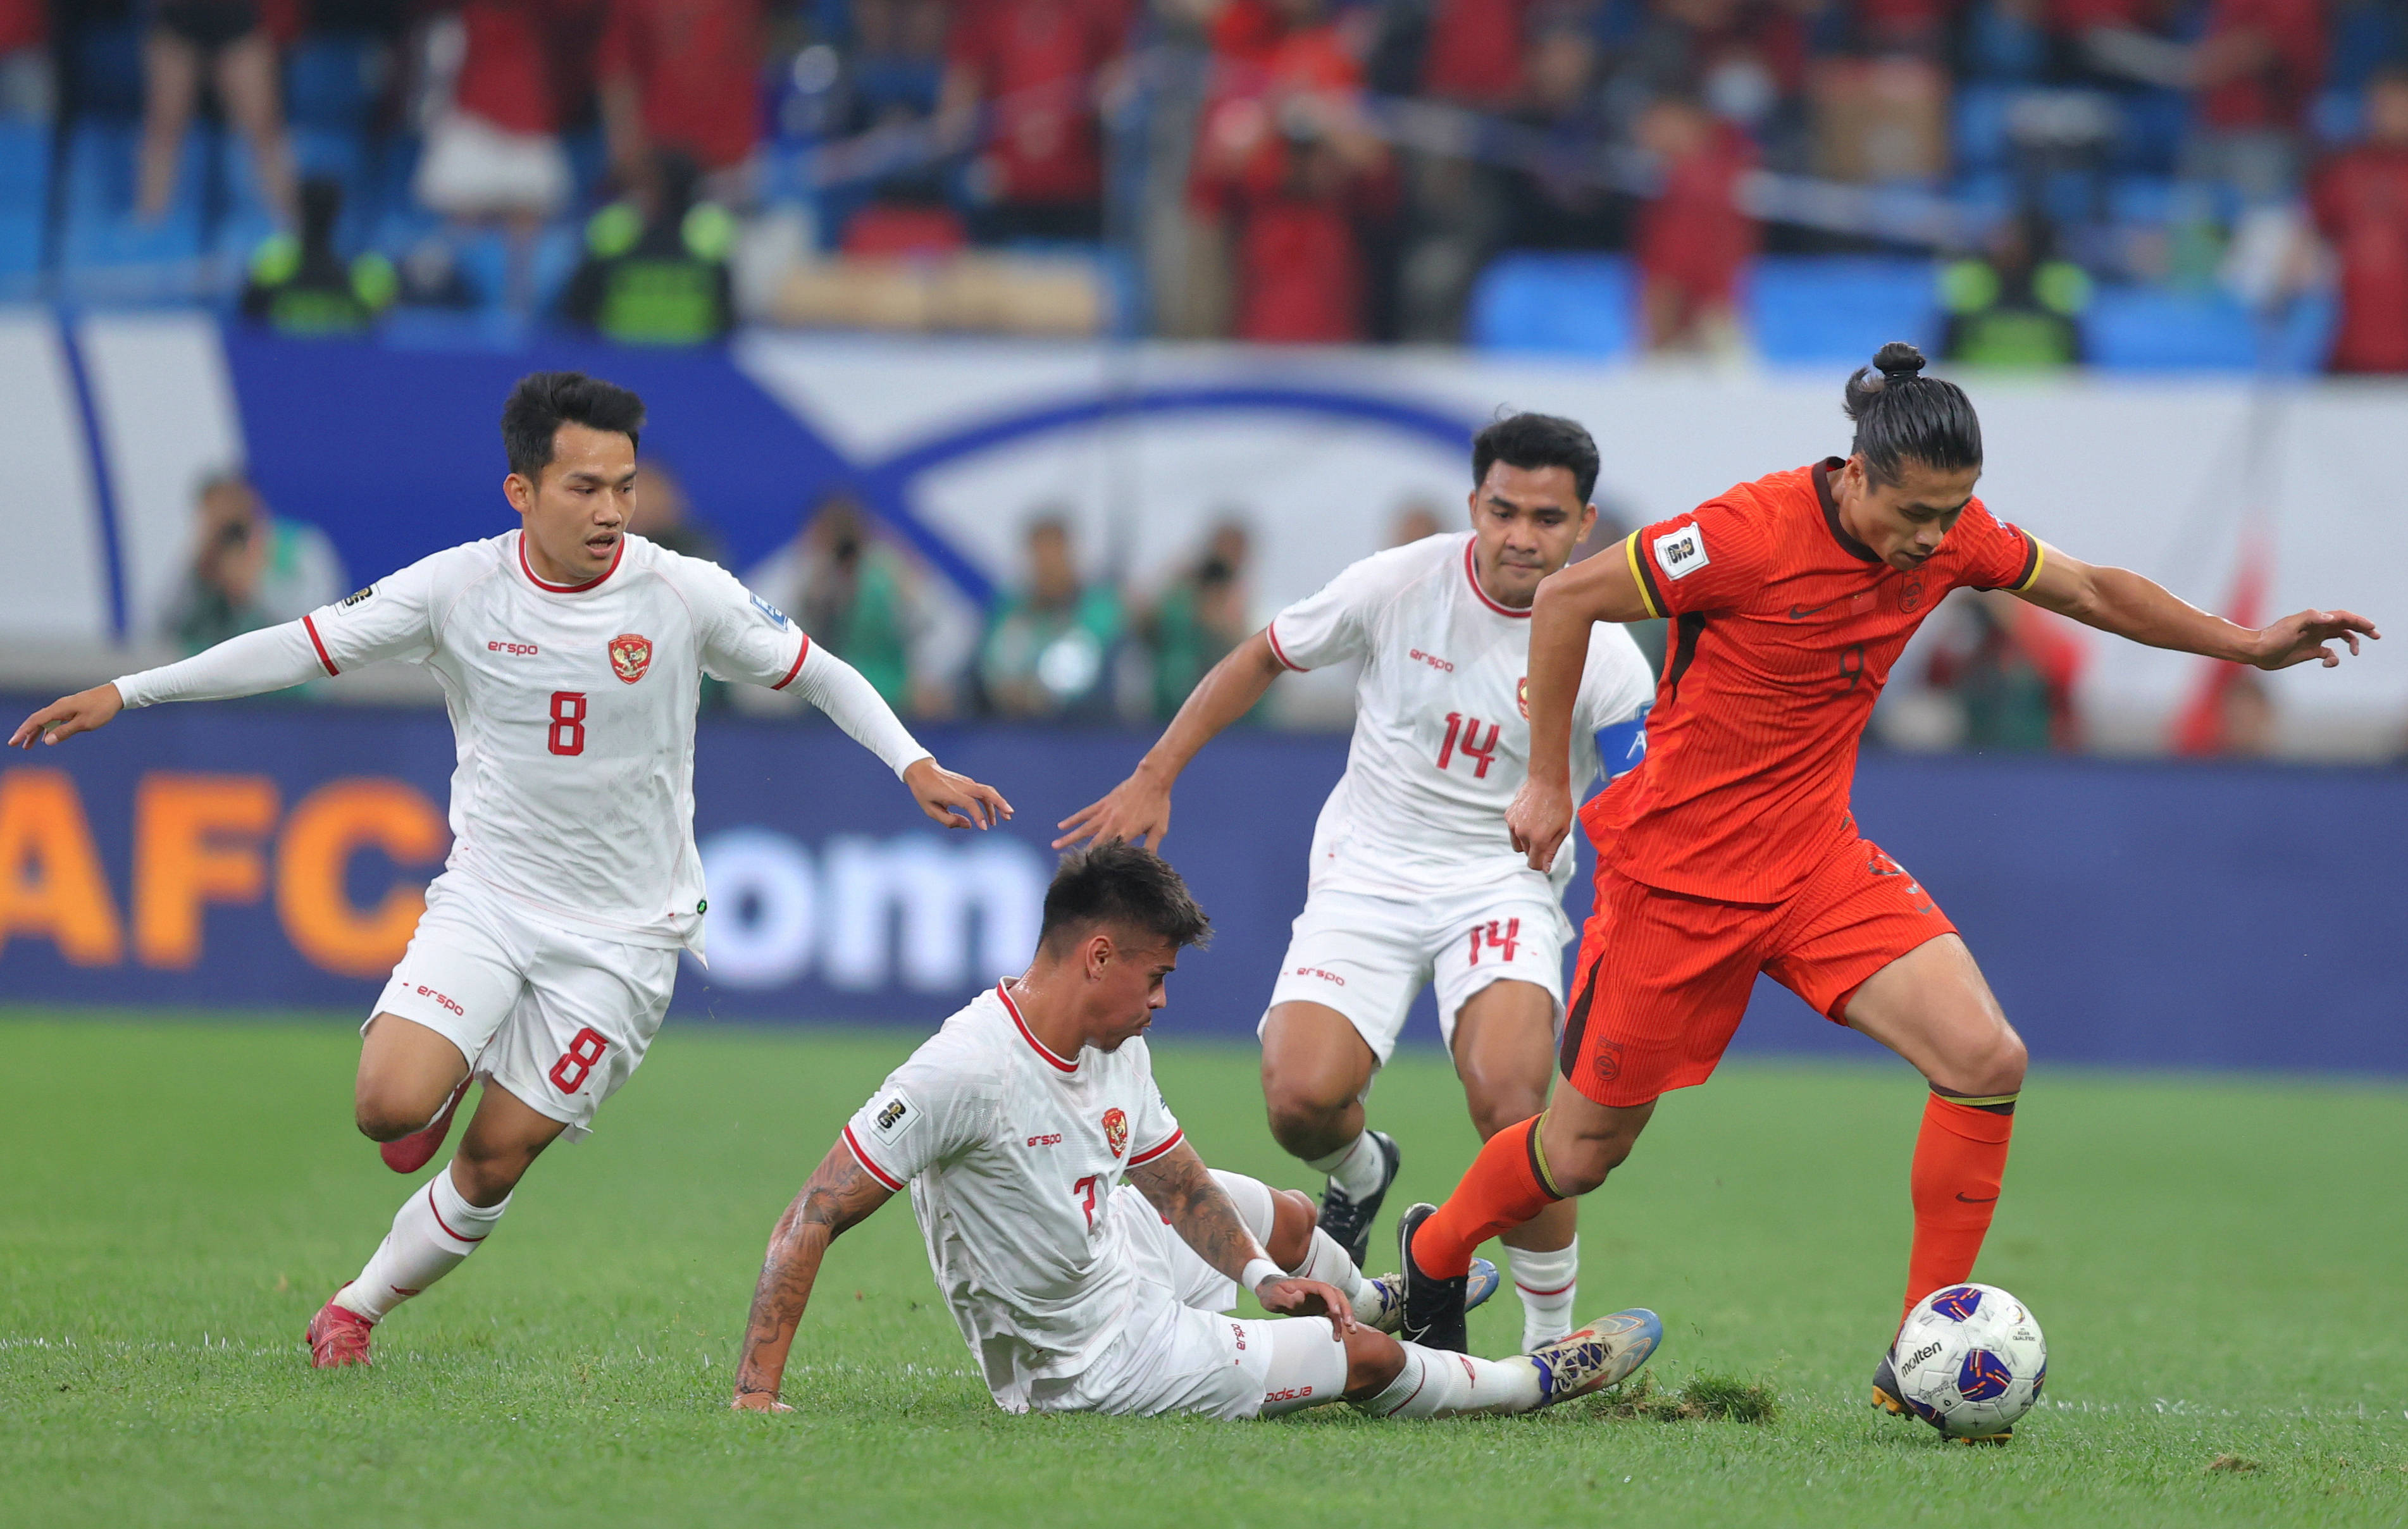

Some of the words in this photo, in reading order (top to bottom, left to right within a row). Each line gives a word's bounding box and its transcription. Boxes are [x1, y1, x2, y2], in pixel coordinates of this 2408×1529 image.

[488, 640, 538, 656] erspo
[1409, 648, 1454, 674] erspo
[1839, 643, 1864, 691] 9
[548, 691, 587, 757] 8
[1436, 711, 1501, 780] 14
[0, 765, 447, 980] AFC
[1469, 917, 1521, 967] 14
[1296, 967, 1346, 987] erspo
[416, 984, 464, 1017] erspo
[549, 1027, 610, 1095] 8
[1027, 1133, 1062, 1148] erspo
[1073, 1173, 1099, 1230] 7
[1231, 1323, 1246, 1351] erspo
[1900, 1340, 1943, 1378] molten
[1264, 1385, 1313, 1402] erspo
